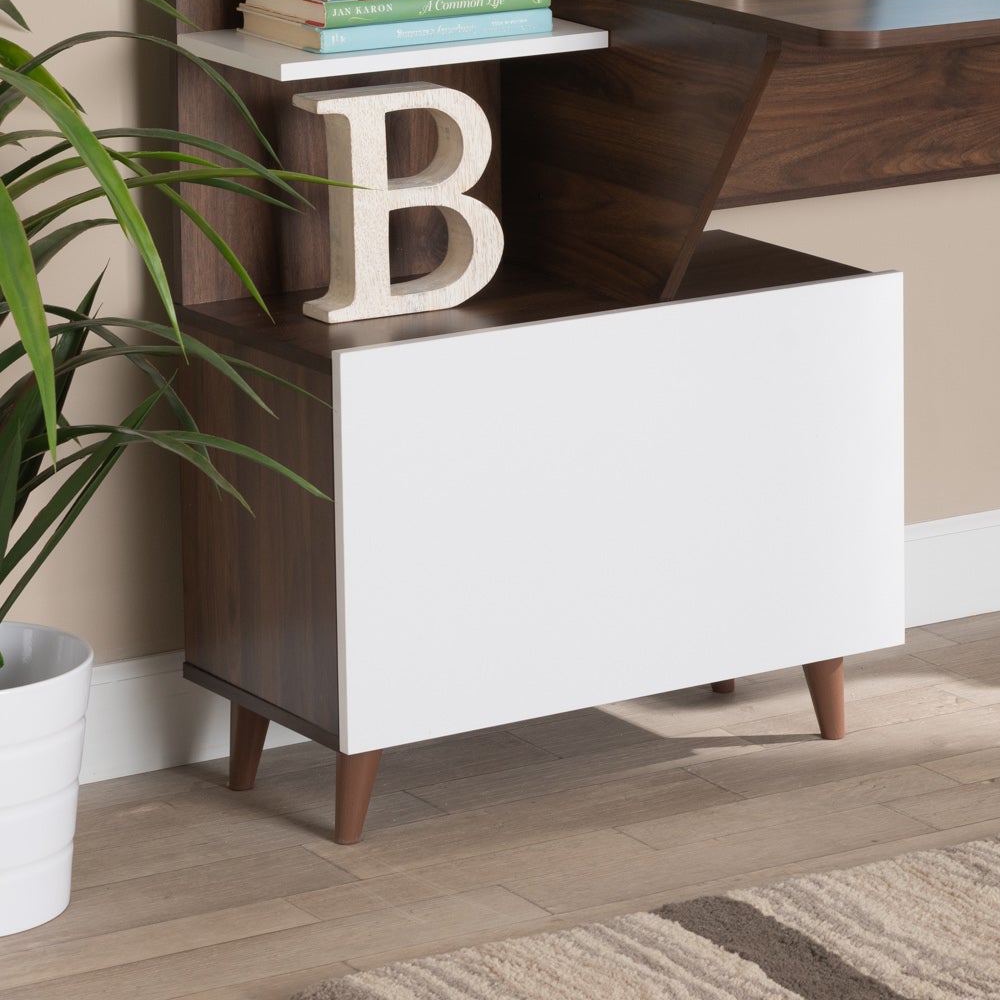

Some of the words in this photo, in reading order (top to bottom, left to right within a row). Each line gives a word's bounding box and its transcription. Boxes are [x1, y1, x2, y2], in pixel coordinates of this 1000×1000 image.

[332, 6, 351, 17] JAN
[355, 3, 393, 15] KARON
[418, 0, 432, 15] A
[434, 0, 484, 11] Common
[292, 81, 505, 324] B
